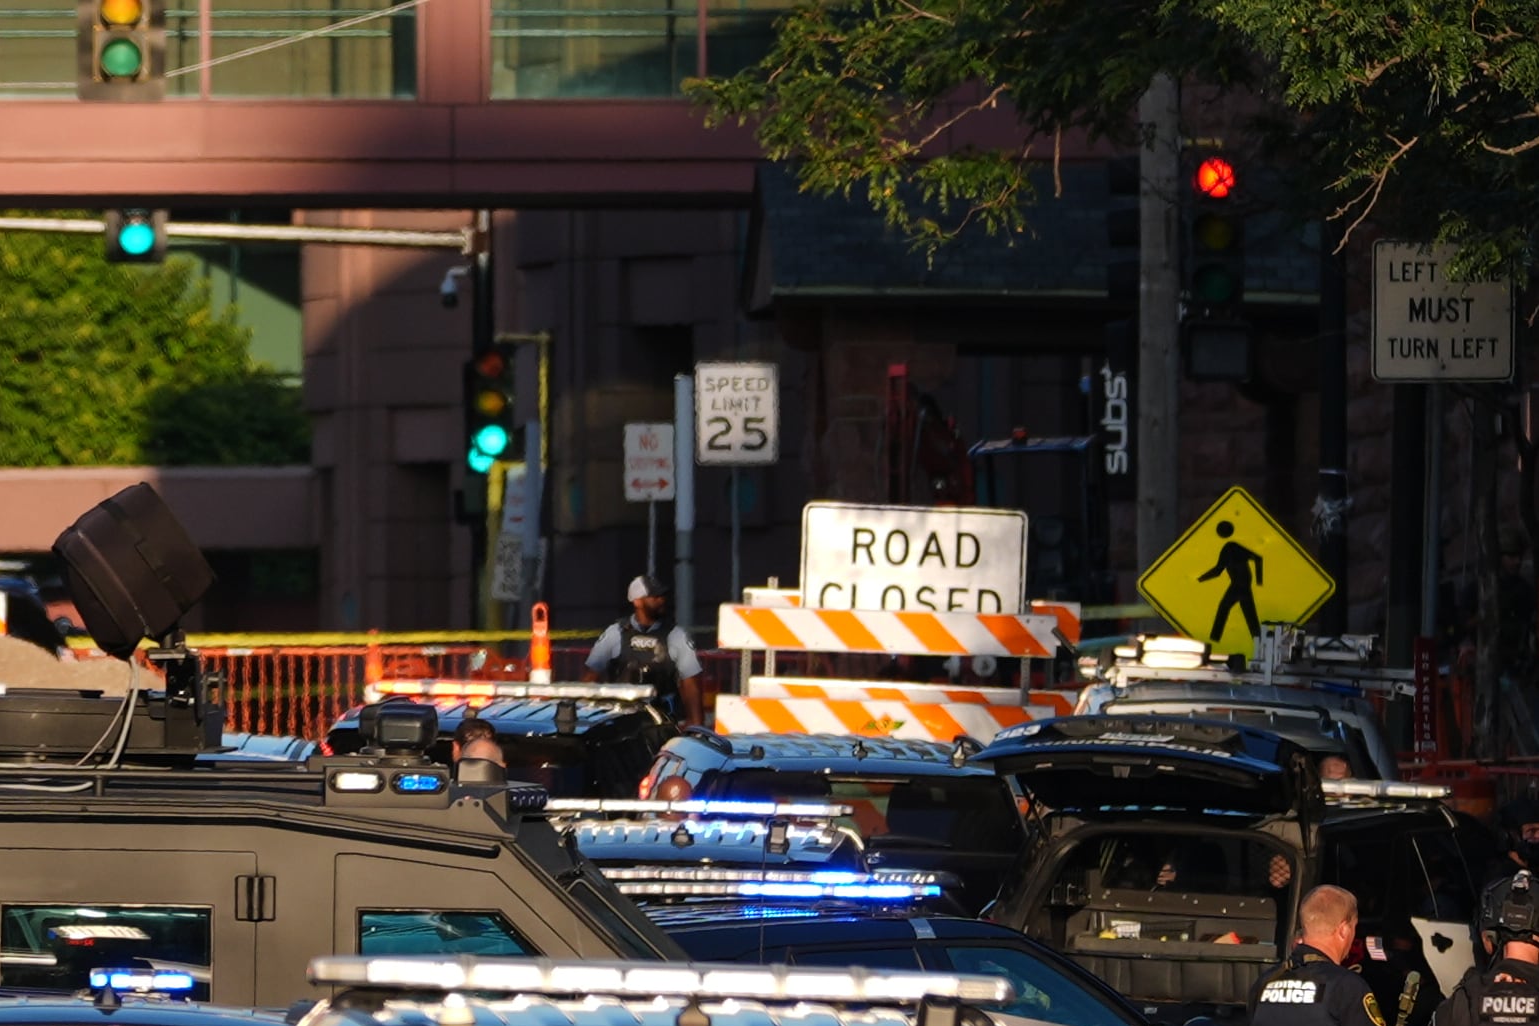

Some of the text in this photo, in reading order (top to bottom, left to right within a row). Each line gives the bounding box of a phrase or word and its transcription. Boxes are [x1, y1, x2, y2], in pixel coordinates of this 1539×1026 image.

[1389, 261, 1438, 283] LEFT
[1408, 298, 1475, 323] MUST
[1388, 338, 1499, 360] TURN LEFT
[705, 377, 770, 393] SPEED
[711, 398, 761, 412] LIMIT
[706, 416, 768, 451] 25
[851, 527, 981, 569] ROAD
[1260, 989, 1317, 1004] POLICE
[1482, 997, 1536, 1014] POLICE
